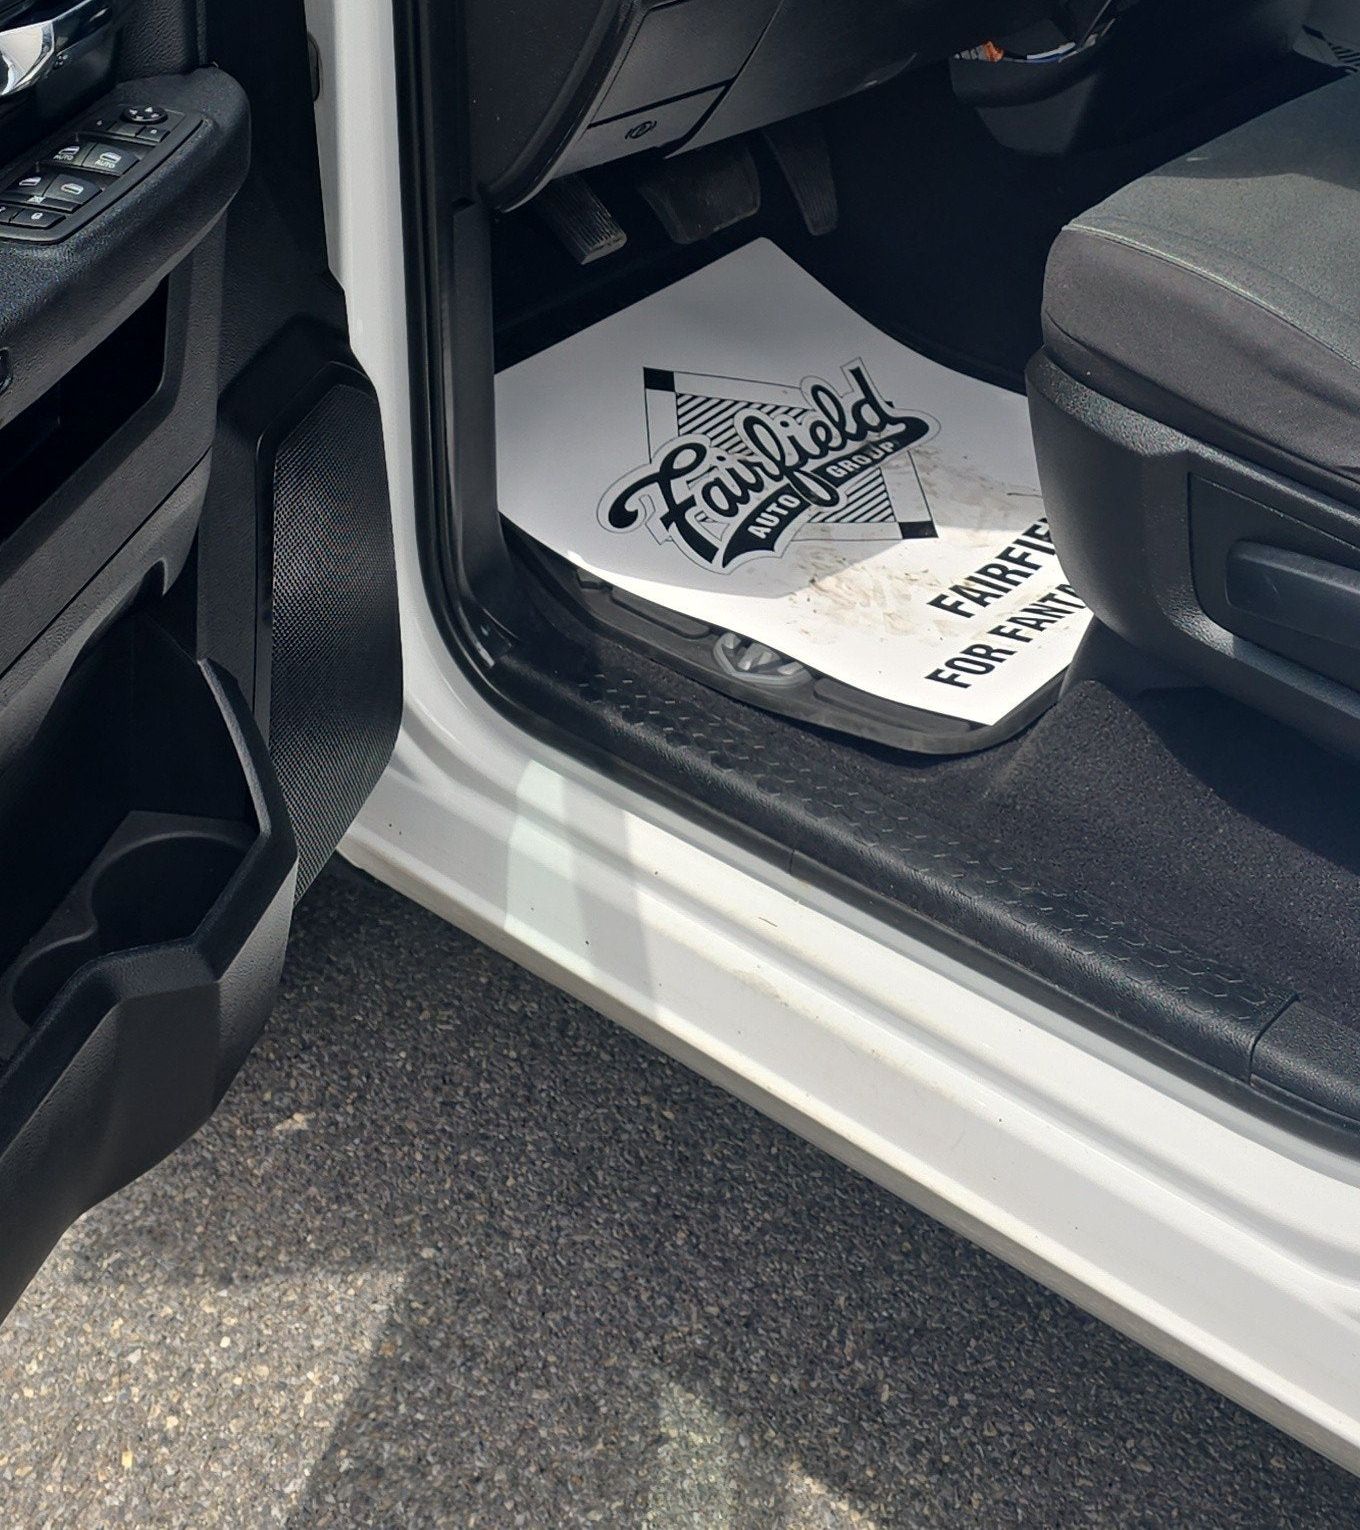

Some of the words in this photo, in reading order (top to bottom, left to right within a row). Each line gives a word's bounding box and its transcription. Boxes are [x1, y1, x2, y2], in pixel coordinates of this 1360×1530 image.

[95, 159, 116, 169] AUTO
[608, 367, 929, 563] Fairfield
[747, 494, 801, 539] AUTO
[825, 441, 895, 478] GROUP
[924, 643, 1018, 689] FOR
